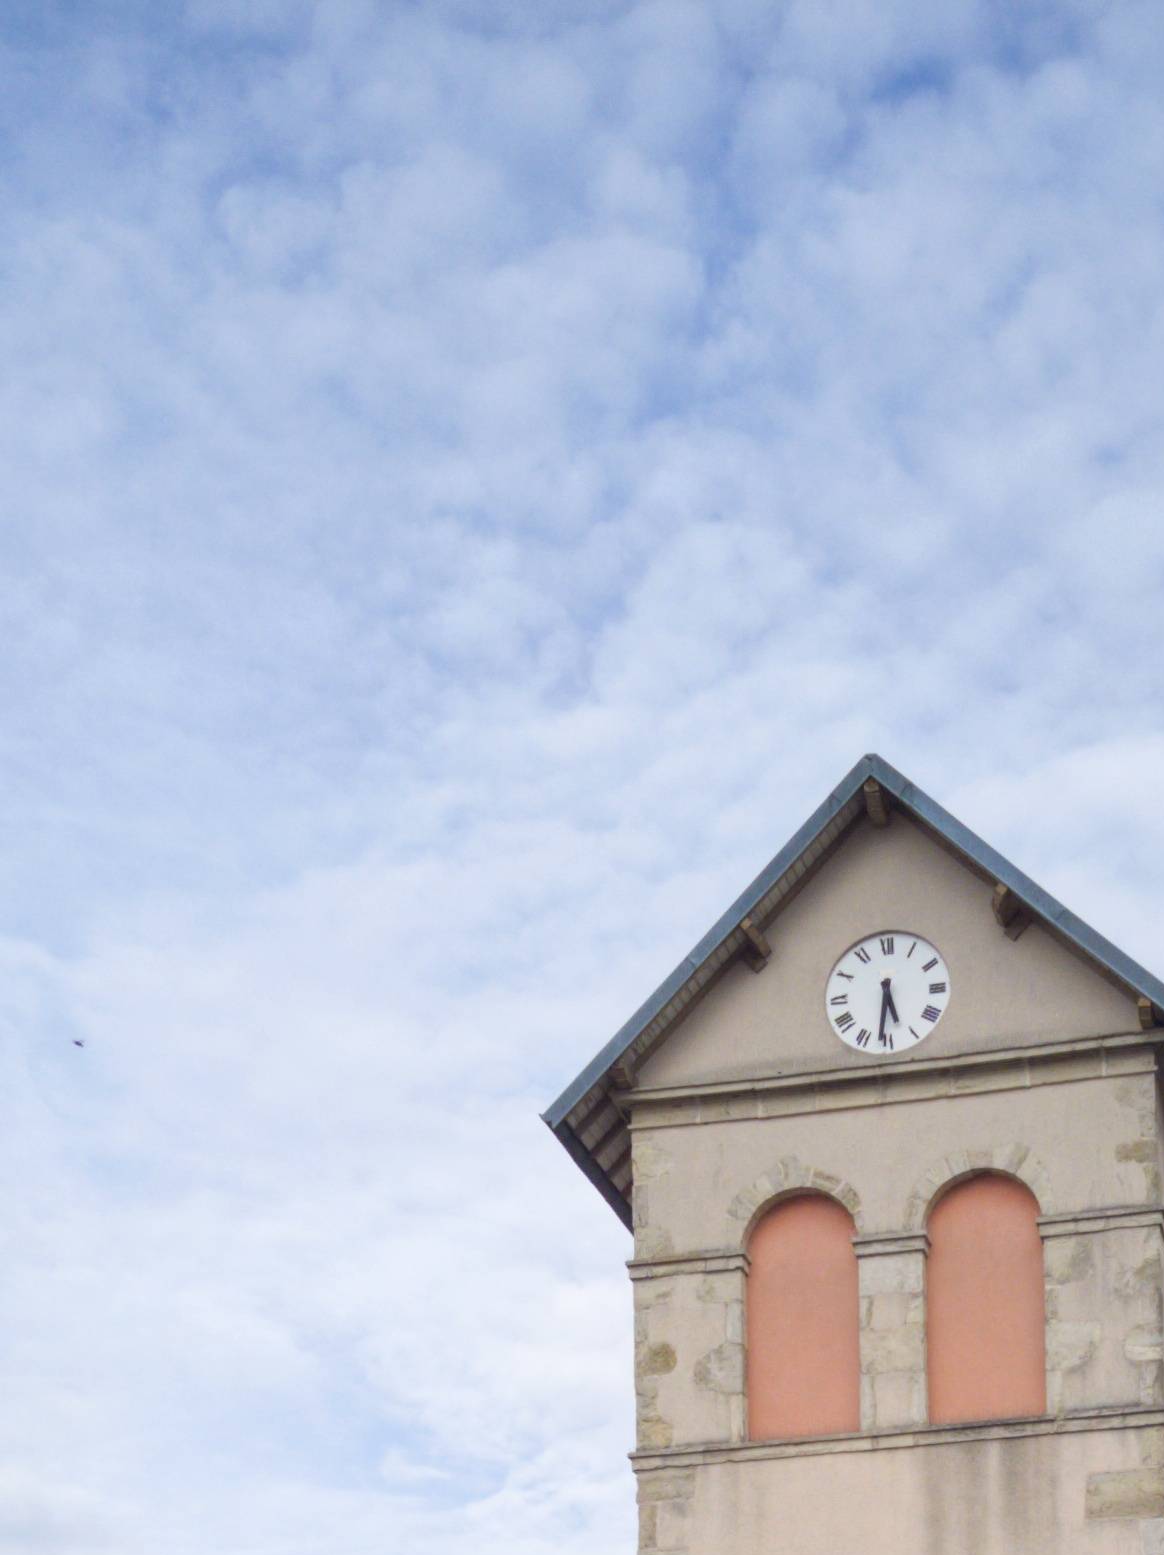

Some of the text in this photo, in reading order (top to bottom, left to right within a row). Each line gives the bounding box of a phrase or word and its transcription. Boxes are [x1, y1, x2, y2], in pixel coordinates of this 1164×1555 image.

[880, 937, 894, 955] XII
[907, 942, 917, 958] I
[854, 947, 871, 964] XI
[922, 958, 939, 972] II
[837, 970, 854, 982] X
[929, 982, 946, 994] III
